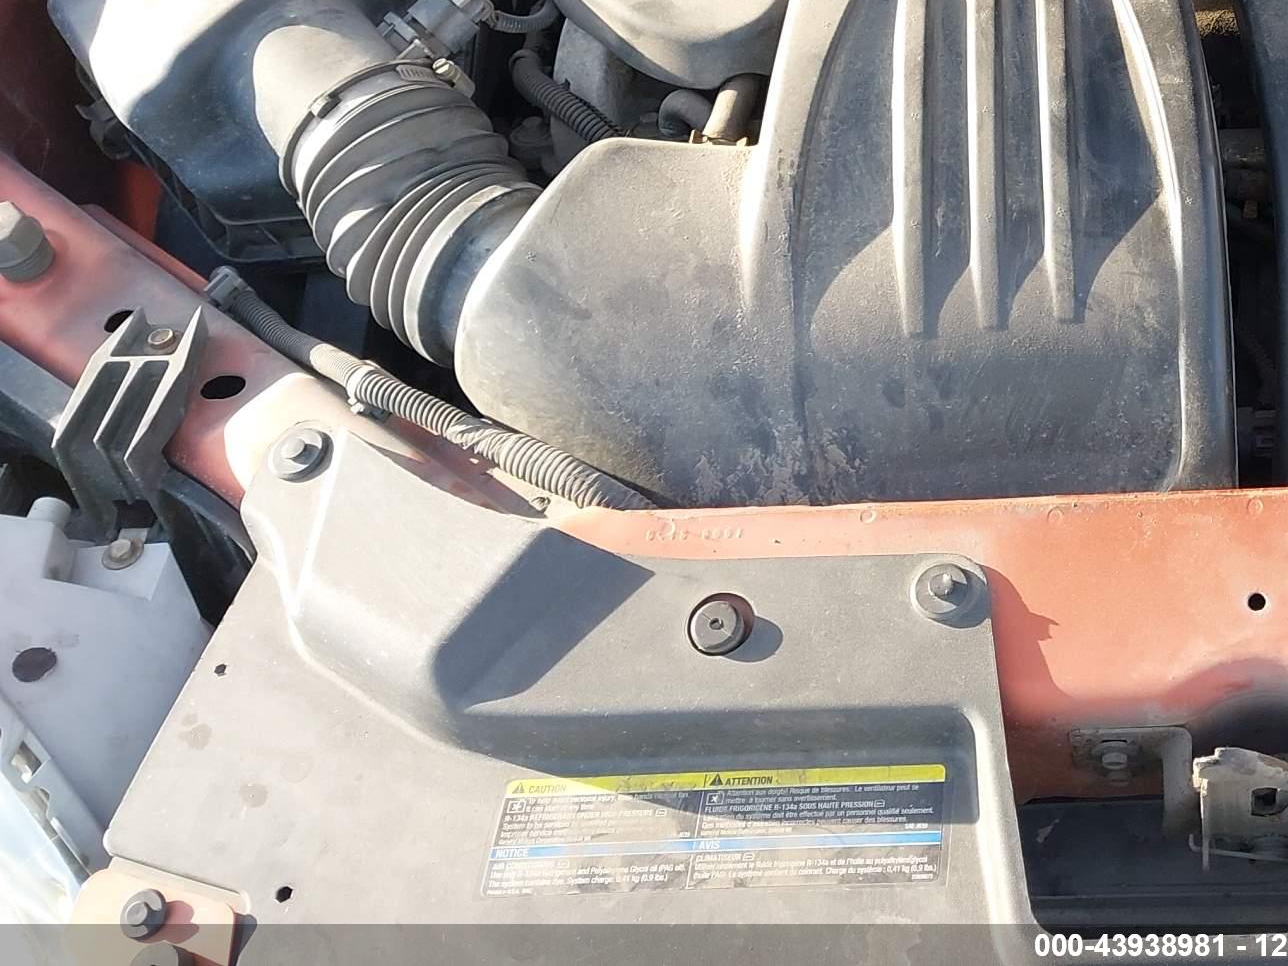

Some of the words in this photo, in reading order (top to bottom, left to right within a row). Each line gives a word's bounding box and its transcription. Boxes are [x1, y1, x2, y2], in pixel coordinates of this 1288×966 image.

[725, 776, 773, 786] ATTENTION
[528, 785, 567, 794] CAUTION
[799, 802, 817, 810] SOUS
[818, 801, 840, 809] HAUTE
[841, 800, 874, 809] PRESSION
[699, 840, 720, 850] AVIS
[495, 848, 529, 858] NOTICE
[695, 854, 741, 862] CLIMATISEUR
[807, 858, 829, 866] R-134a
[577, 867, 590, 875] and
[659, 864, 673, 872] (PAG
[825, 866, 847, 875] Charge
[848, 866, 856, 874] du
[901, 864, 910, 874] kg
